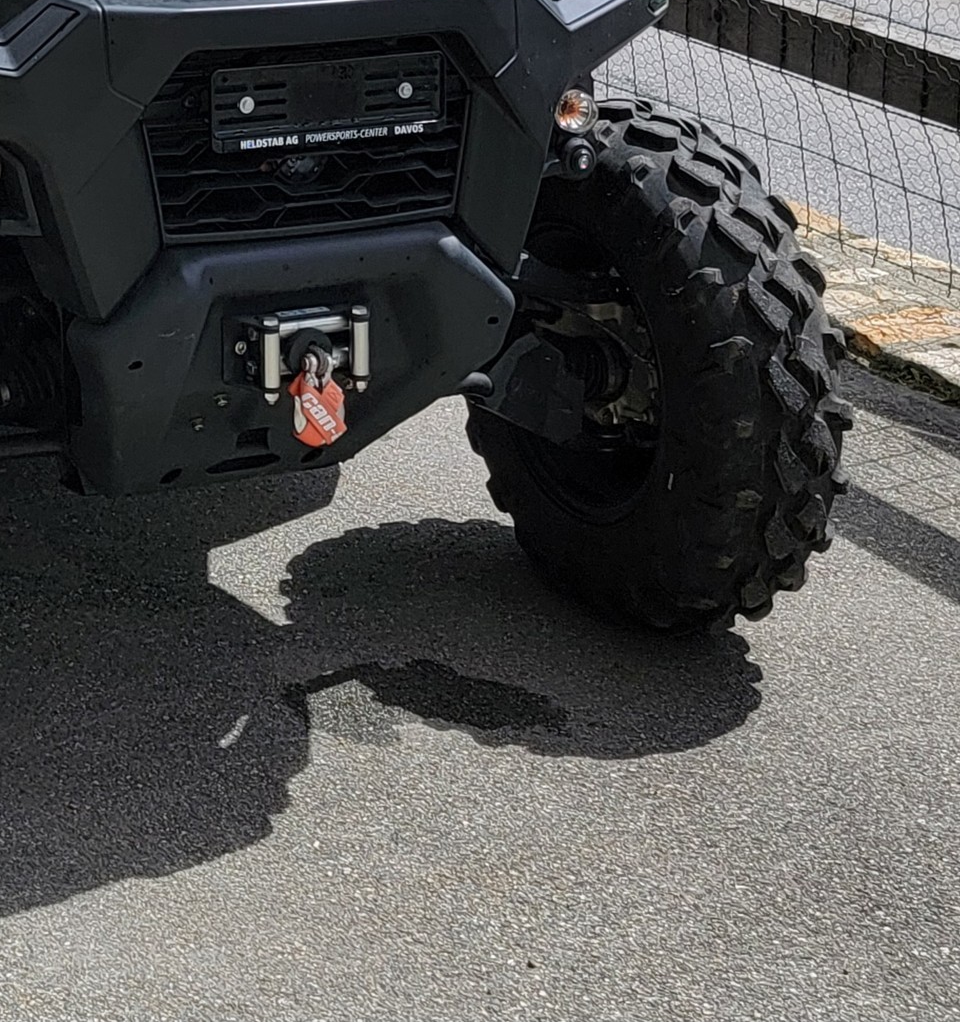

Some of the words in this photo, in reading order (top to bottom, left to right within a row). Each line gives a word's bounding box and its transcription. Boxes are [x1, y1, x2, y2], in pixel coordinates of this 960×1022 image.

[240, 136, 285, 150] HELDSTAB
[286, 135, 299, 145] AG
[305, 127, 389, 144] POWERSPORTS-CENTER
[394, 124, 424, 135] DAVOS
[301, 392, 343, 442] can-
